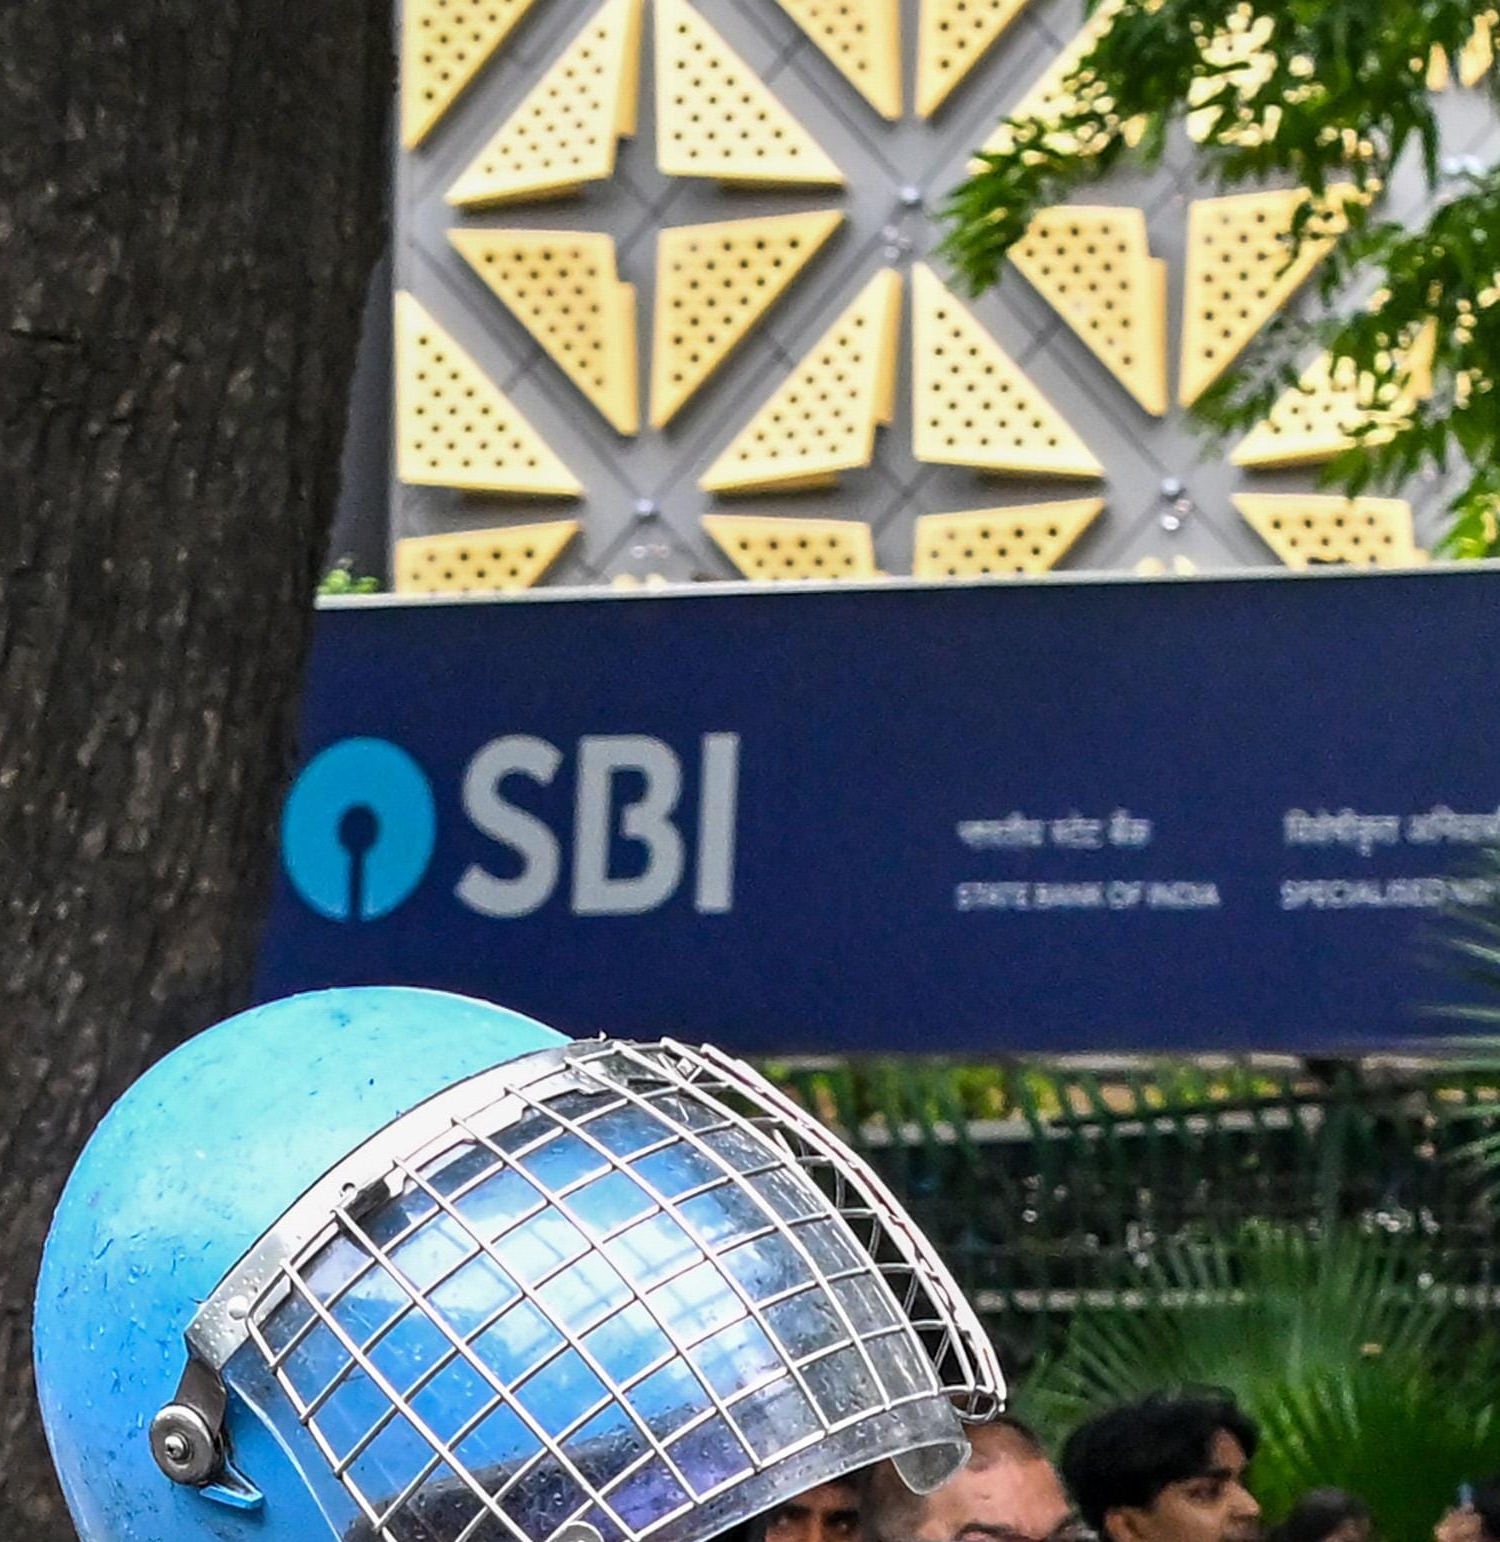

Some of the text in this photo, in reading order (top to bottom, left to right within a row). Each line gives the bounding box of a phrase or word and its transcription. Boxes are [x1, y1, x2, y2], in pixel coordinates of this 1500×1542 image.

[453, 731, 742, 919] SBI
[956, 880, 1221, 911] STATE BANK OF INDIA
[1280, 878, 1444, 910] SPECIALISED
